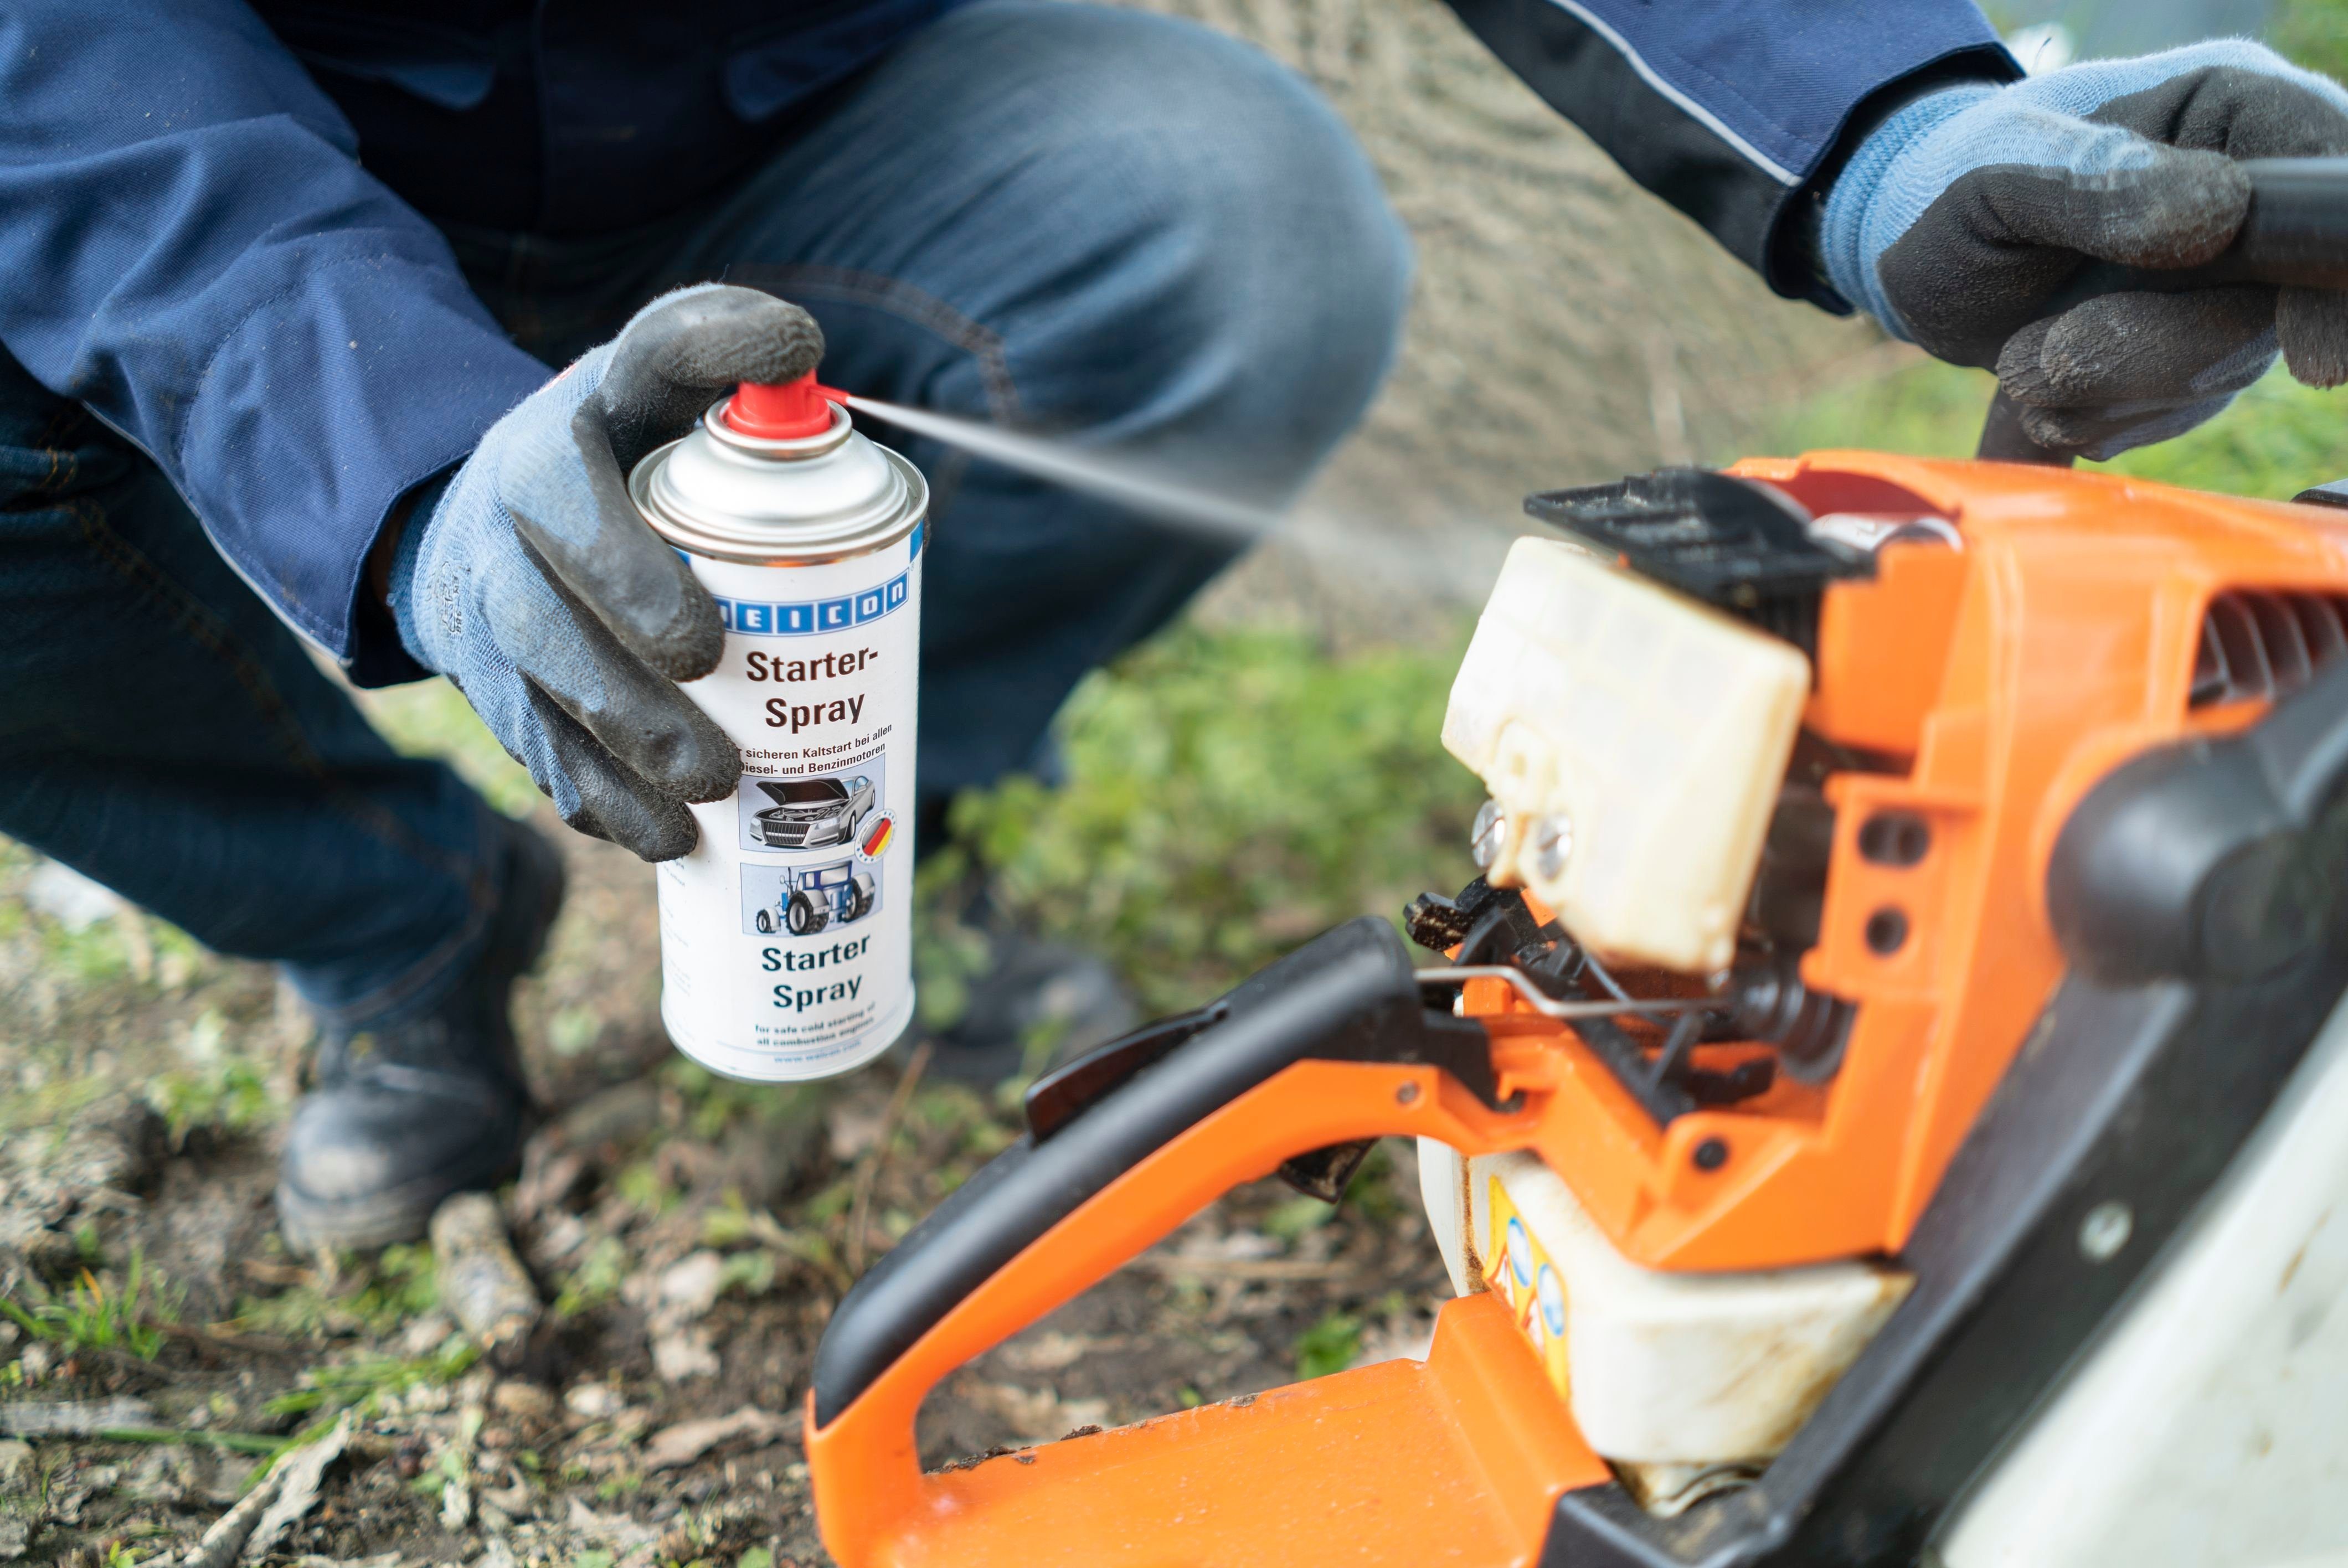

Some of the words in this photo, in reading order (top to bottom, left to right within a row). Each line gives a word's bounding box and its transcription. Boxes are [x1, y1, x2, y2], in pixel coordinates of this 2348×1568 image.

[746, 647, 878, 683] Starter-
[765, 693, 865, 734] Spray
[746, 748, 798, 760] sicheren
[803, 741, 852, 759] Kaltstart
[855, 734, 869, 748] bei
[872, 724, 892, 740] allen
[782, 764, 804, 775] und
[809, 742, 885, 773] Benzinmotoren
[762, 934, 870, 972] Starter
[773, 974, 862, 1013] Spray
[755, 1024, 769, 1033] for
[775, 1025, 797, 1034] safe
[801, 1021, 824, 1033] cold
[756, 1037, 769, 1046] all
